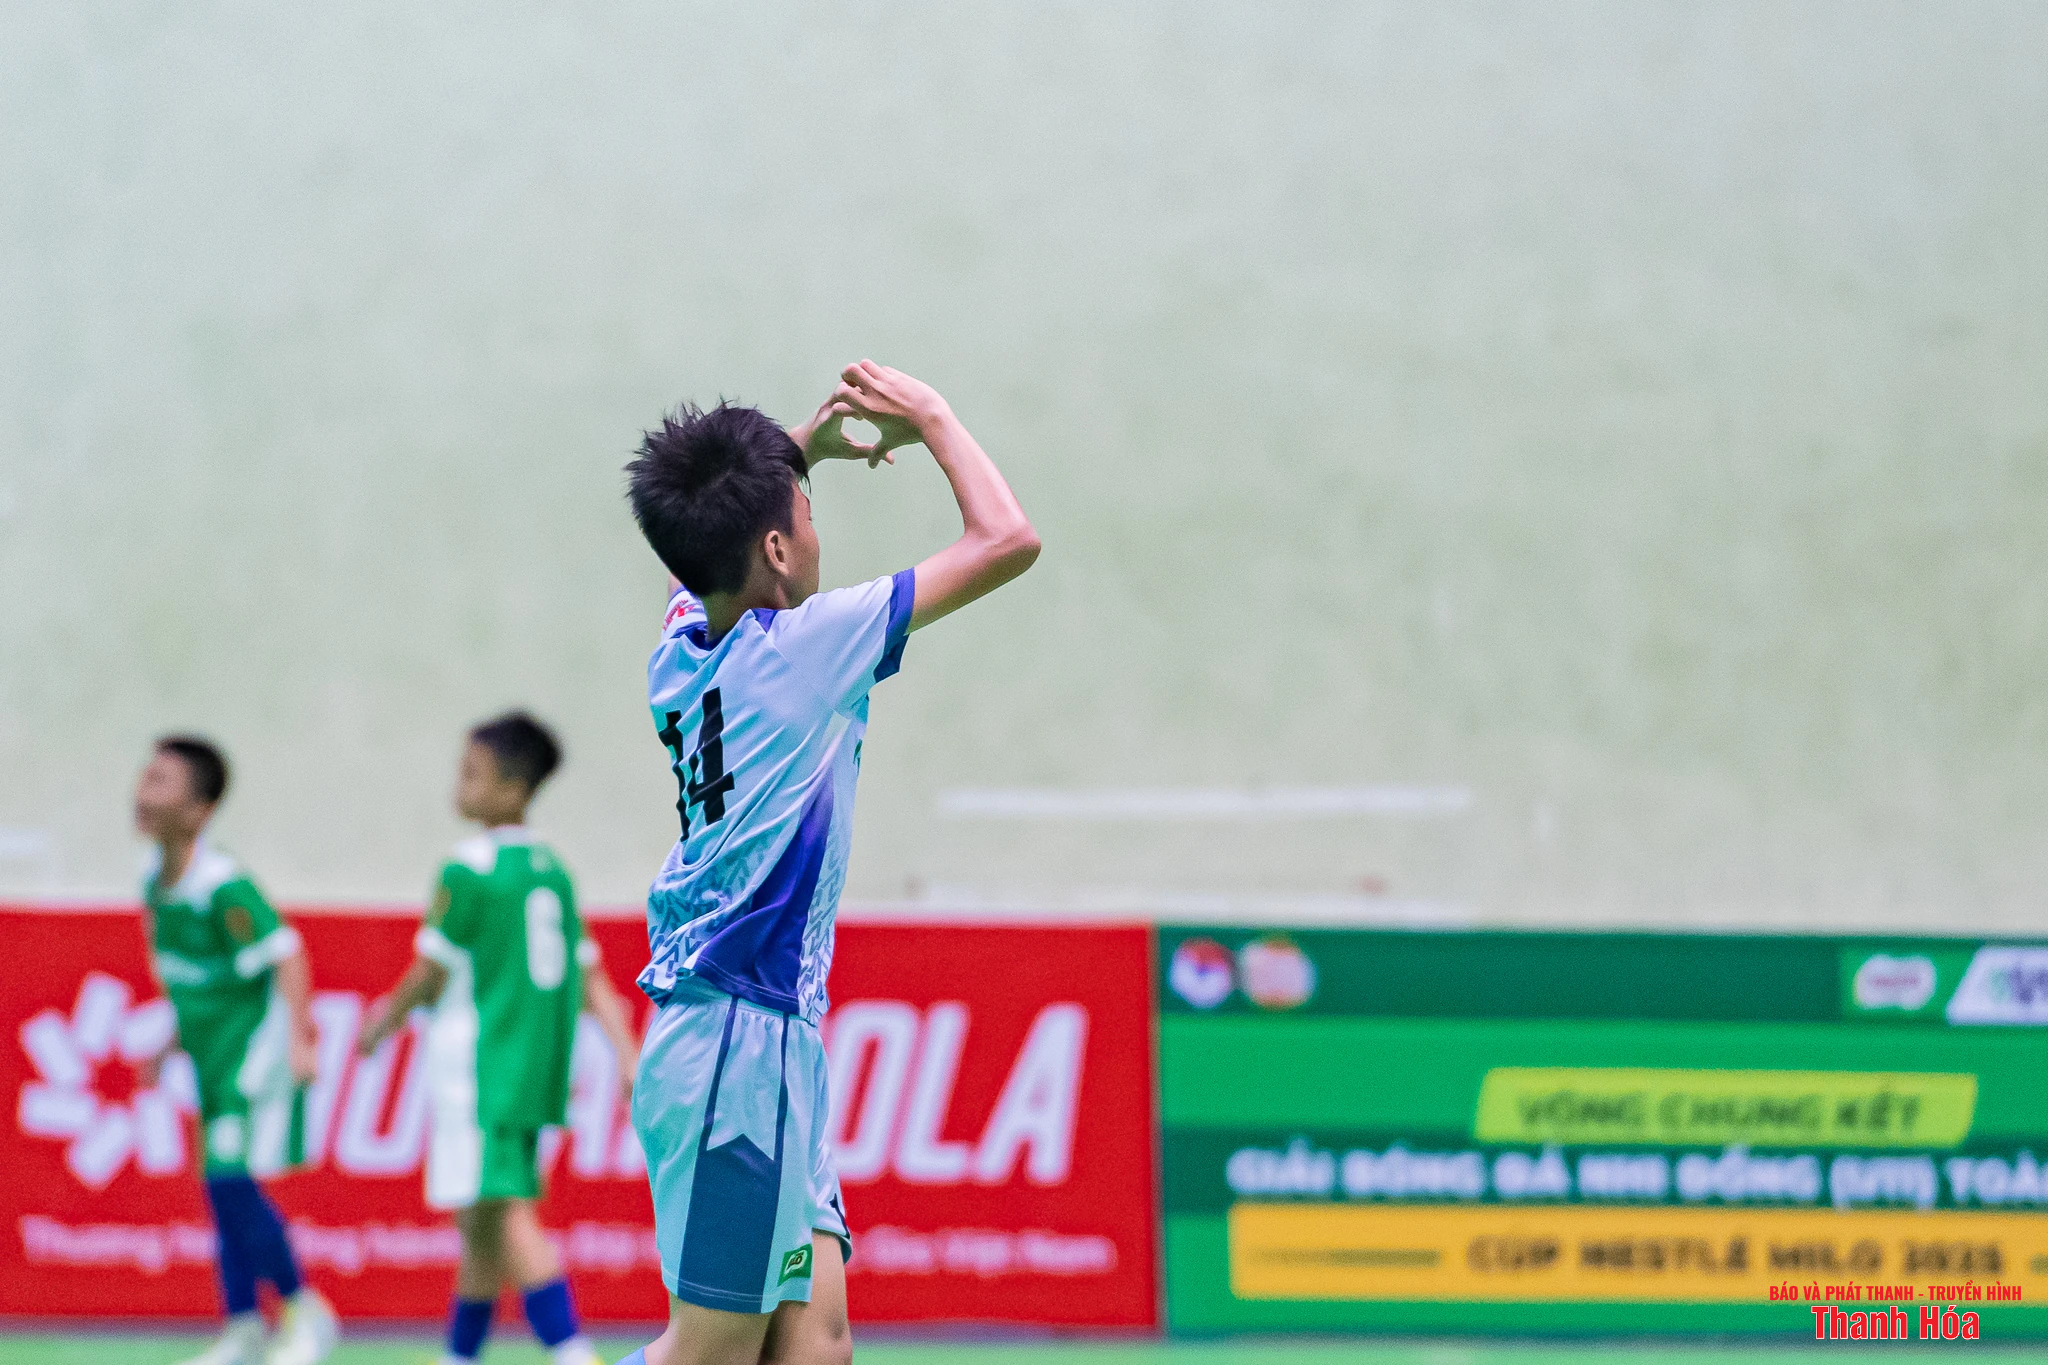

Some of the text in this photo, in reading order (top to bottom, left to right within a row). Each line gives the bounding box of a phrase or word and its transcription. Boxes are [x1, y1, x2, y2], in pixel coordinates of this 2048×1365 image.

[658, 686, 735, 842] 14
[1657, 1090, 1823, 1135] CHUNG
[1944, 1147, 2048, 1203] TOÀ
[1578, 1229, 1749, 1277] NESTLÉ
[1766, 1236, 1886, 1278] MILO
